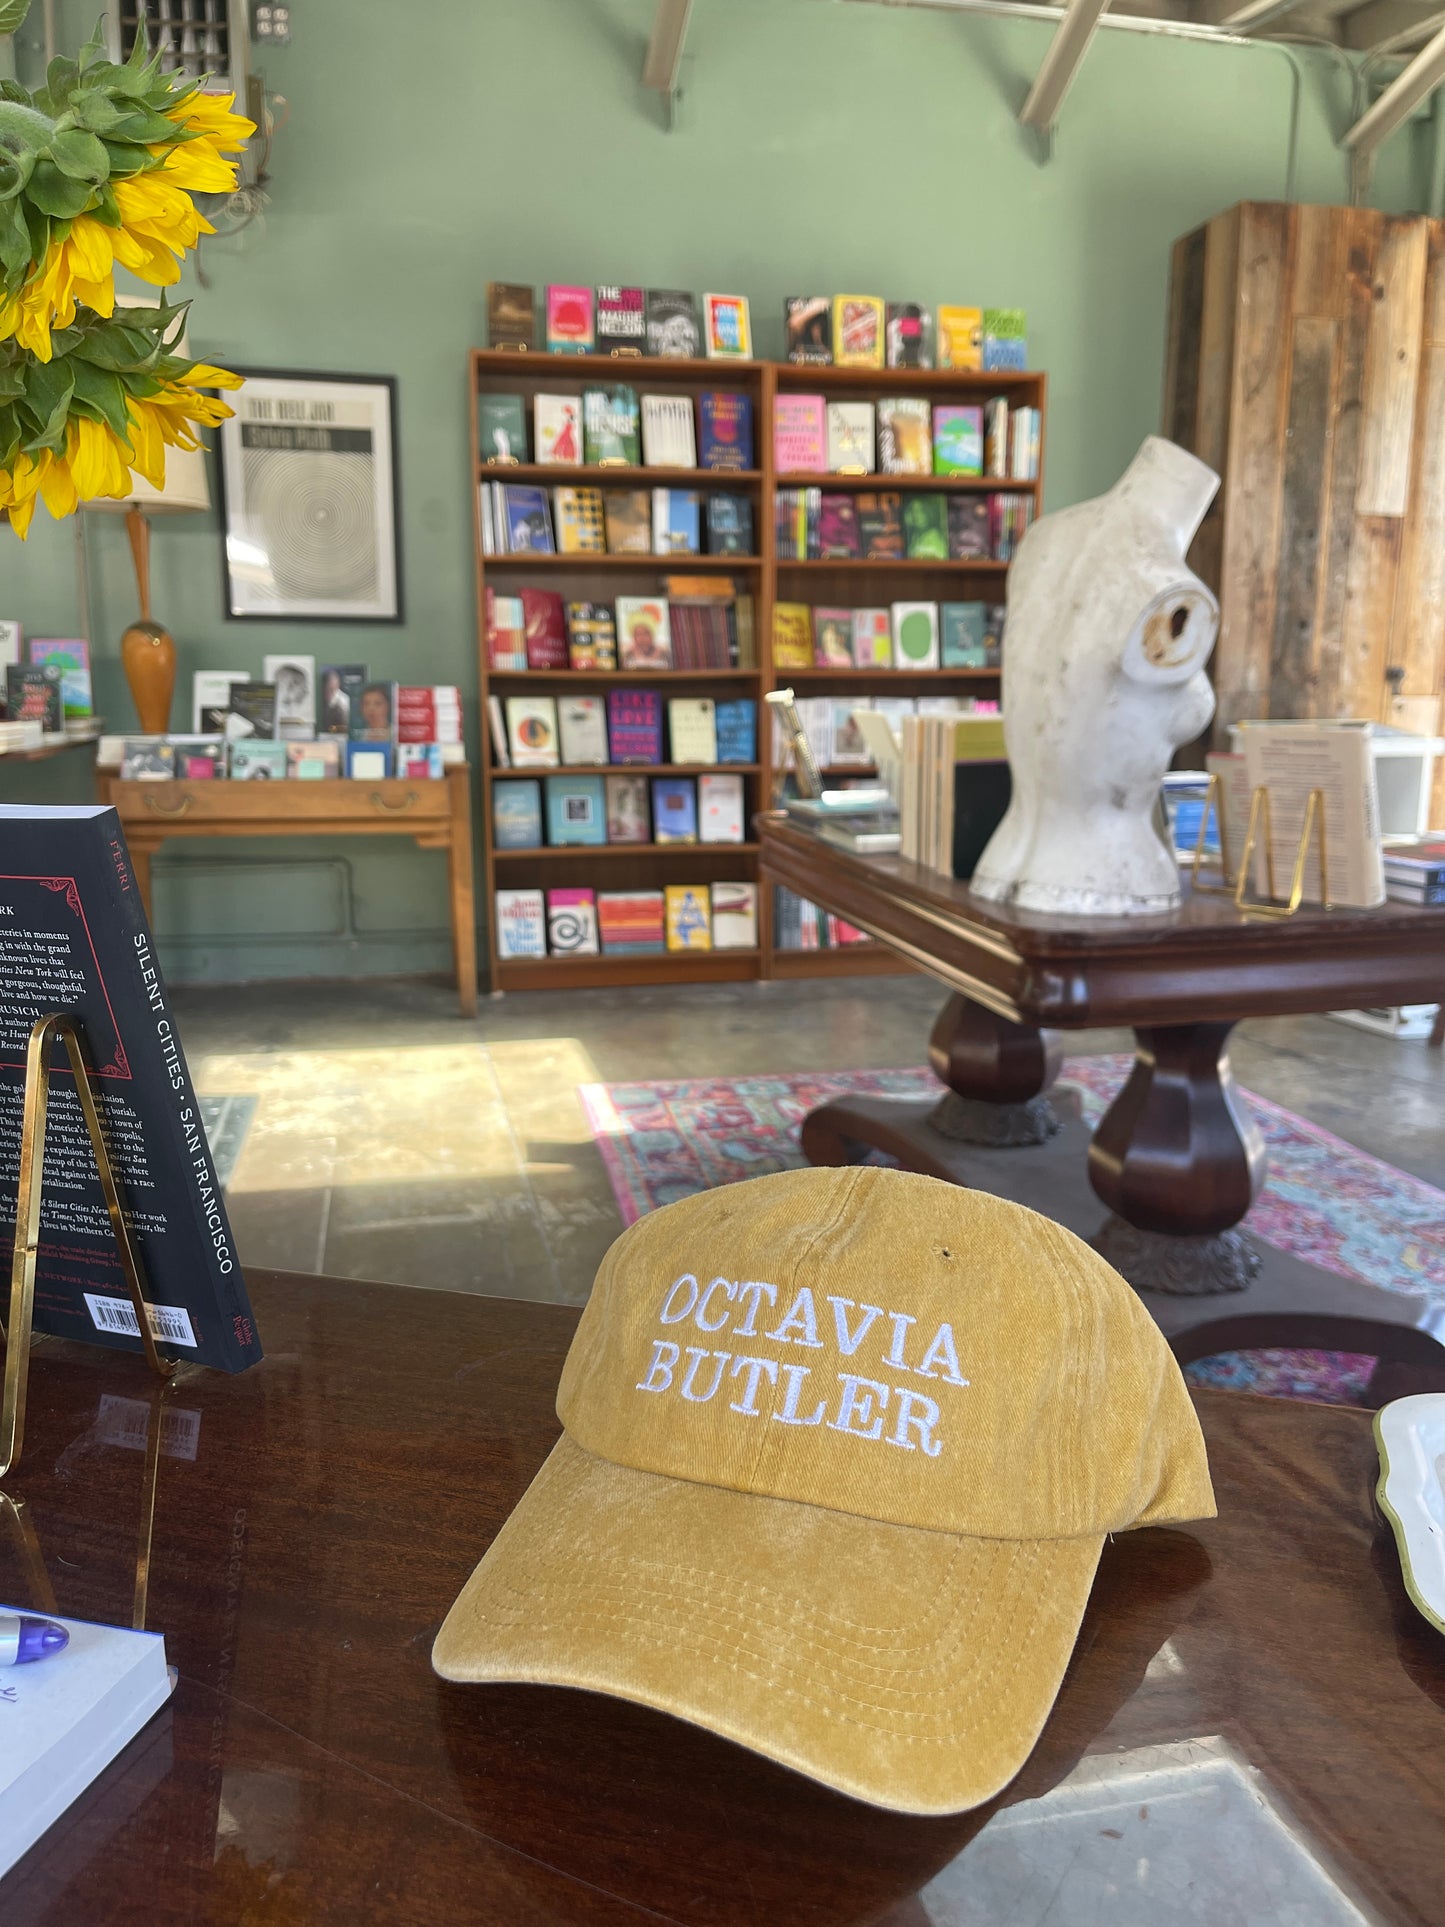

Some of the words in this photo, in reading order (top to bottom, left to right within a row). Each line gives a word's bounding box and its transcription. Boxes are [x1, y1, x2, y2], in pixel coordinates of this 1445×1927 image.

[23, 929, 32, 938] in
[34, 932, 70, 941] moments
[5, 940, 14, 950] in
[14, 941, 32, 951] with
[33, 942, 46, 952] the
[47, 944, 71, 955] grand
[29, 954, 48, 965] lives
[48, 956, 66, 966] that
[15, 965, 34, 976] New
[35, 967, 52, 977] York
[53, 968, 69, 979] will
[69, 969, 86, 980] feel
[5, 979, 42, 990] gorgeous,
[42, 980, 87, 994] thoughtful,
[16, 990, 31, 1000] and
[30, 991, 48, 1001] how
[48, 994, 60, 1002] we
[4, 1018, 29, 1028] author
[1, 1040, 27, 1051] Records
[47, 1087, 78, 1100] brought
[110, 1105, 137, 1117] burials
[133, 932, 165, 1013] SILENT
[157, 1019, 185, 1090] CITIES
[180, 1107, 202, 1154] SAN
[193, 1155, 233, 1275] FRANCISCO
[114, 1119, 134, 1129] town
[134, 1120, 143, 1130] of
[61, 1134, 76, 1144] But
[123, 1143, 132, 1151] to
[132, 1143, 145, 1153] the
[49, 1146, 87, 1157] expulsion.
[132, 1154, 147, 1164] San
[66, 1158, 75, 1167] of
[76, 1160, 89, 1169] the
[126, 1165, 150, 1176] where
[43, 1167, 60, 1177] dead
[60, 1169, 87, 1180] against
[139, 1179, 156, 1188] race
[47, 1199, 68, 1210] Silent
[69, 1202, 90, 1213] Cities
[131, 1210, 147, 1220] Her
[147, 1213, 168, 1223] work
[50, 1210, 76, 1223] Times,
[75, 1213, 99, 1226] NPR,
[98, 1217, 112, 1227] the
[153, 1223, 167, 1234] the
[60, 1222, 69, 1232] in
[69, 1224, 104, 1237] Northern
[659, 1272, 970, 1387] OCTAVIA
[635, 1339, 943, 1457] BUTLER
